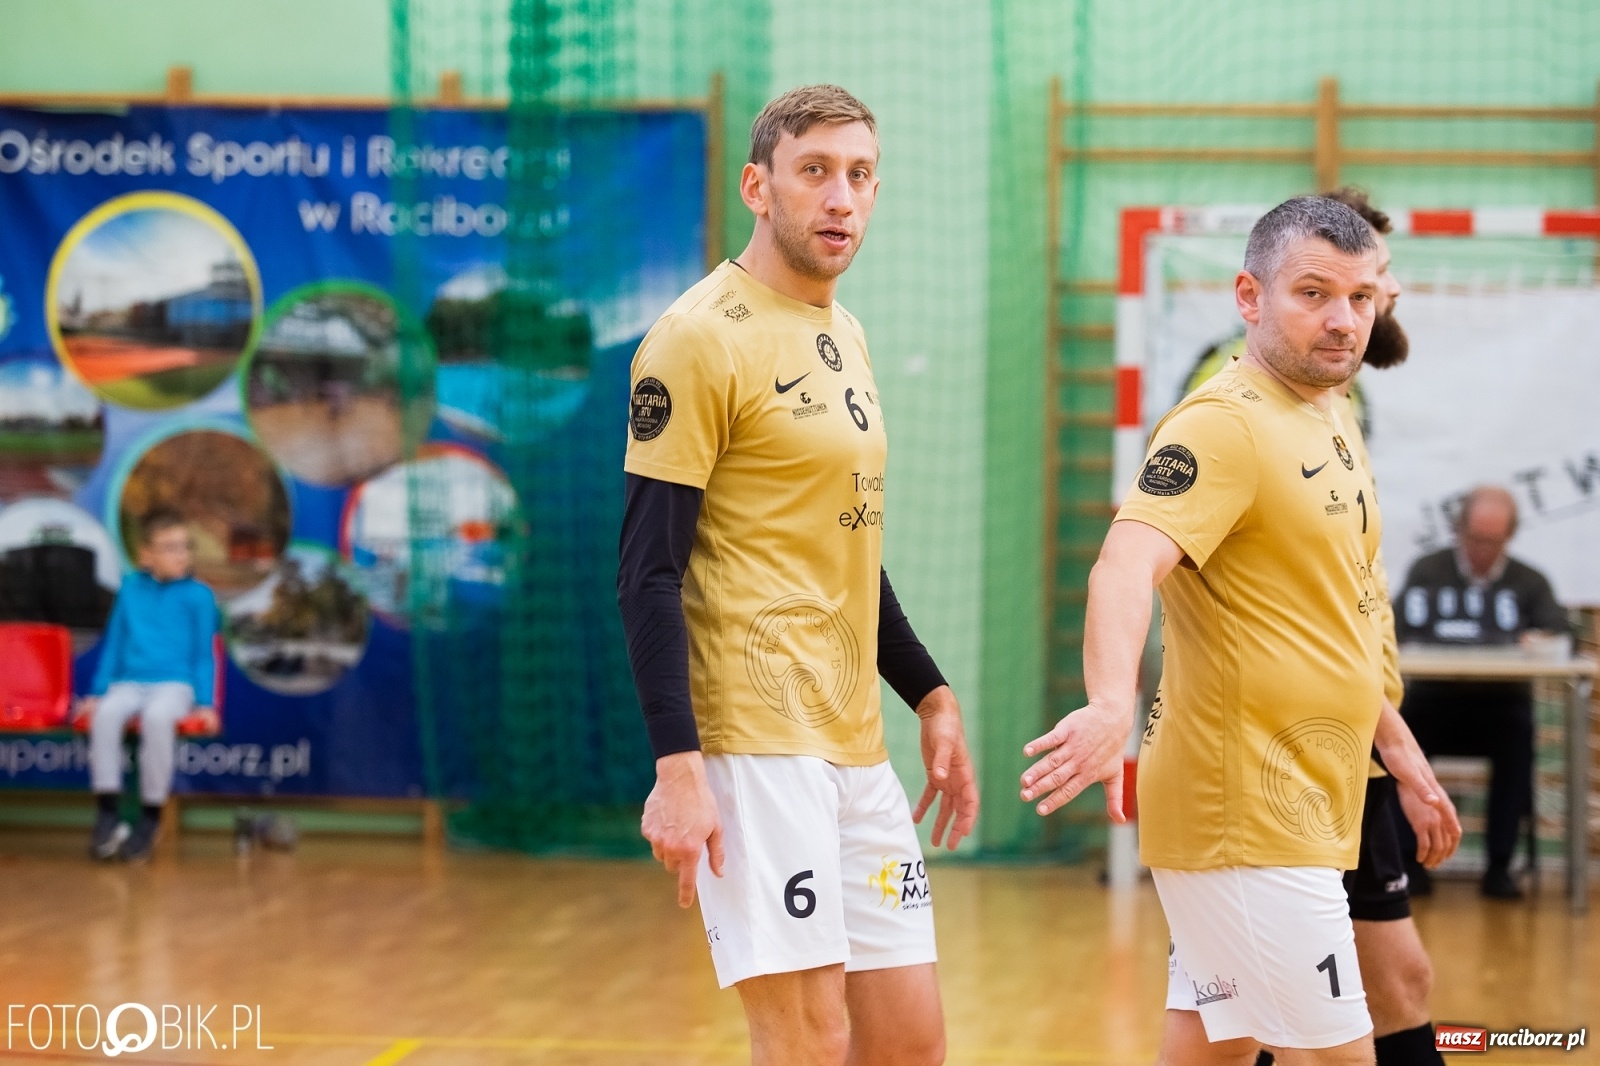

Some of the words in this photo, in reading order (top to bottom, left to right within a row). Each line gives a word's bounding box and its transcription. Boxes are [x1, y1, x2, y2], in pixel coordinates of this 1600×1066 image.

[0, 129, 176, 176] Ośrodek
[186, 133, 330, 184] Sportu
[341, 135, 355, 177] i
[299, 200, 340, 233] w
[845, 387, 868, 431] 6
[1148, 456, 1194, 477] MILITARIA
[1156, 466, 1174, 477] RTV
[1356, 489, 1367, 534] 1
[805, 612, 836, 645] HOUSE
[1316, 736, 1351, 765] HOUSE
[784, 870, 817, 919] 6
[1316, 953, 1341, 998] 1
